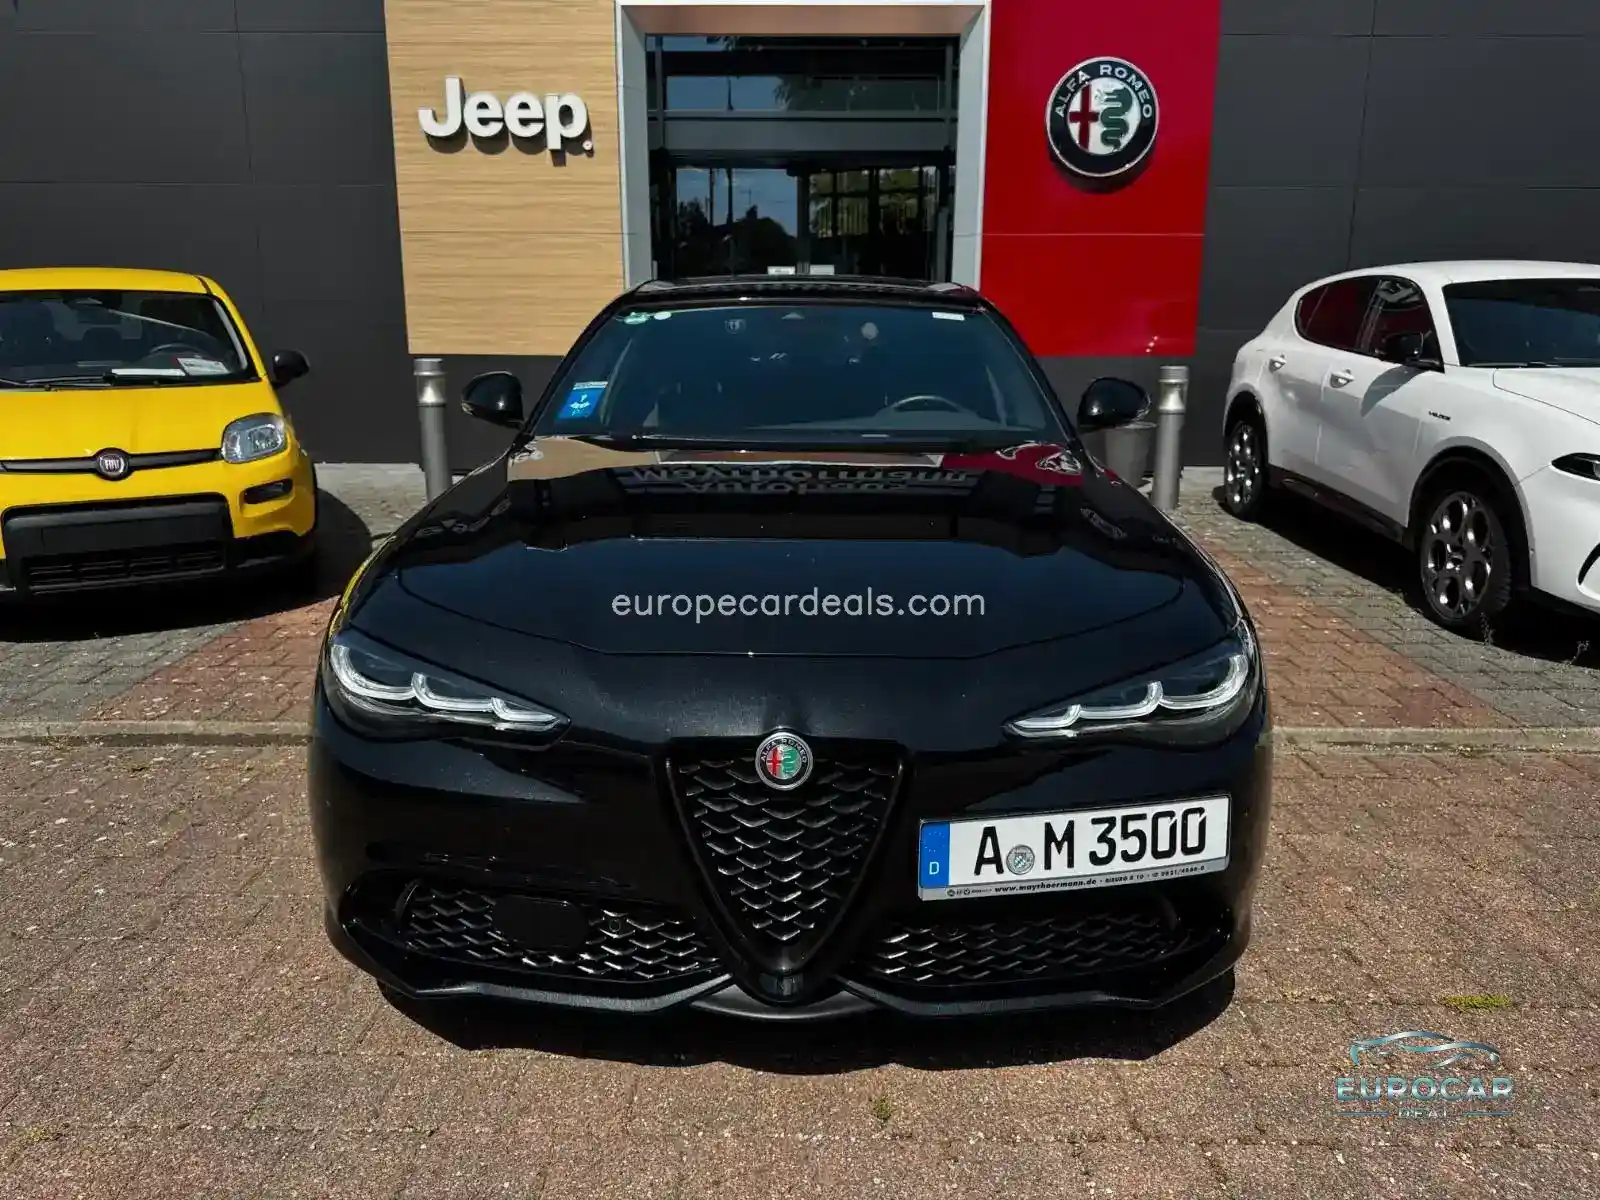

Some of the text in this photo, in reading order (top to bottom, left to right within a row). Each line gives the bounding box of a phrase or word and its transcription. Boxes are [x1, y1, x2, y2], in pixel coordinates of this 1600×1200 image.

[417, 76, 588, 150] Jeep
[1055, 64, 1152, 118] ALFA ROMEO
[929, 862, 940, 875] D
[974, 807, 1206, 876] A M 3500
